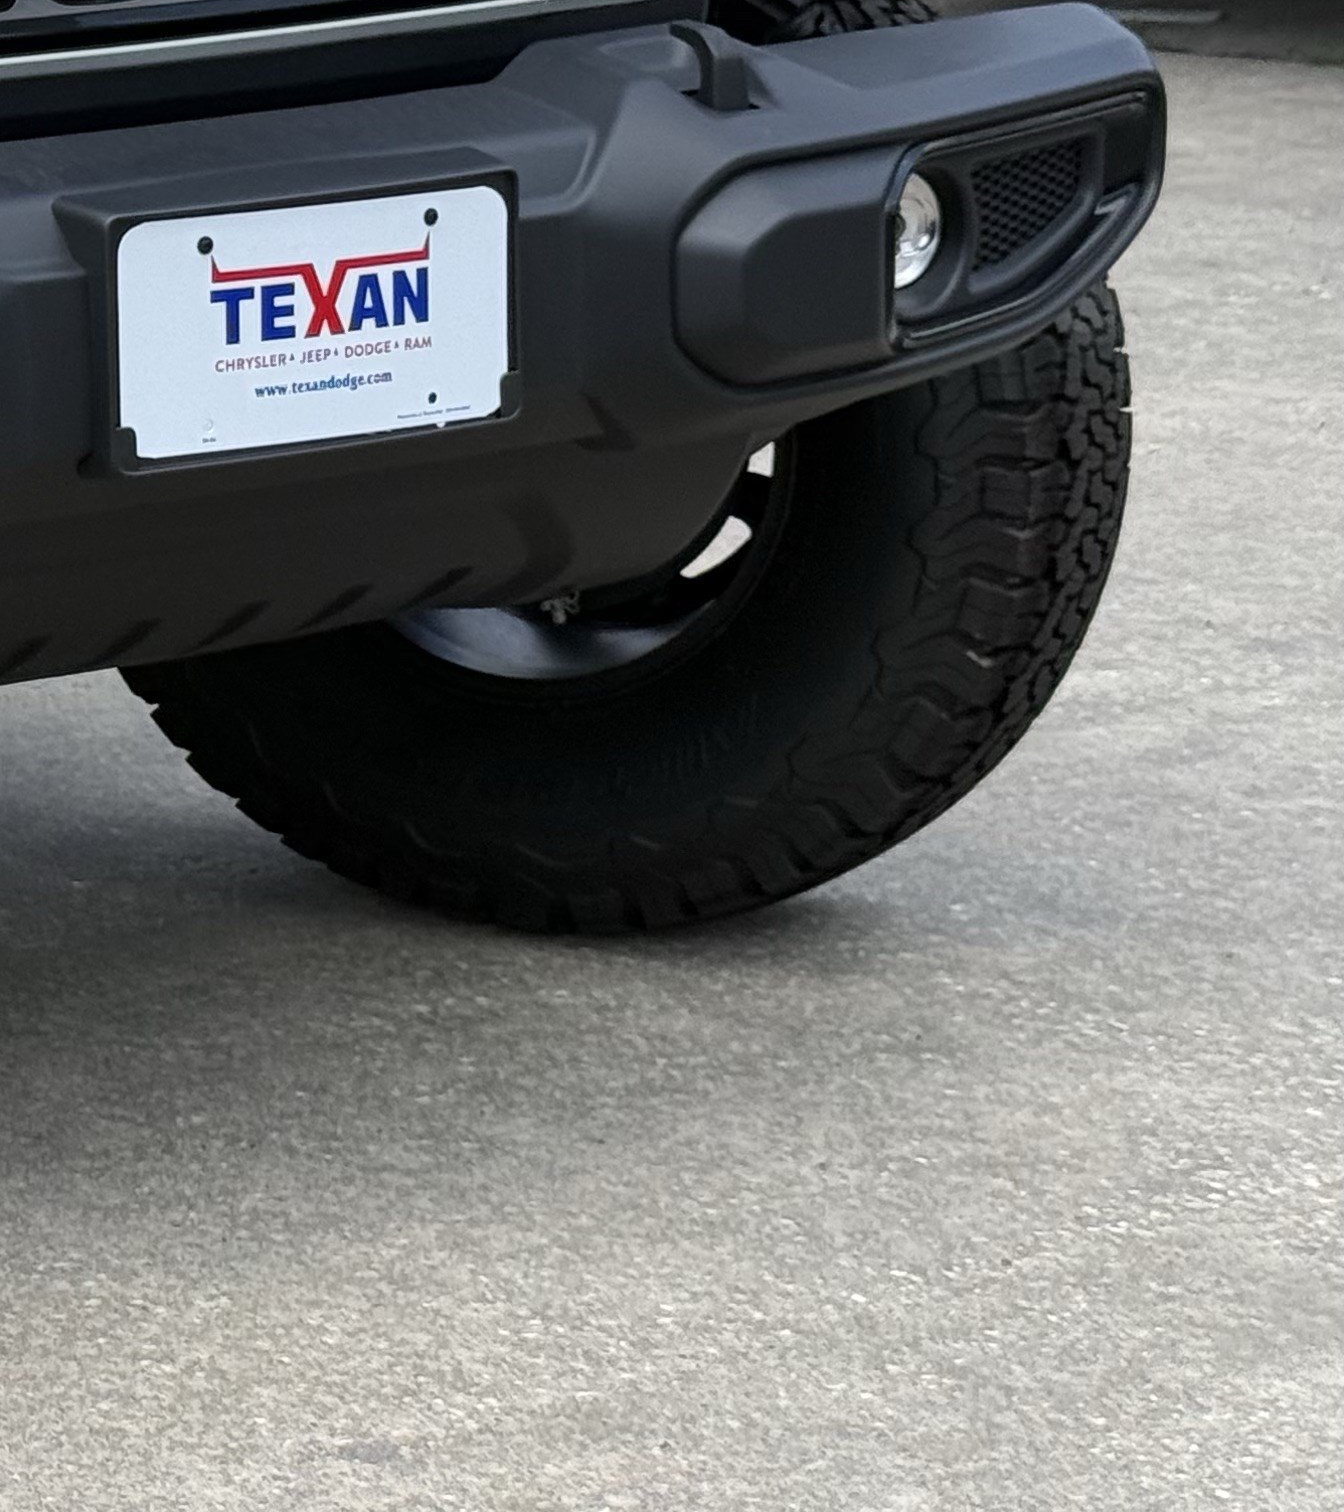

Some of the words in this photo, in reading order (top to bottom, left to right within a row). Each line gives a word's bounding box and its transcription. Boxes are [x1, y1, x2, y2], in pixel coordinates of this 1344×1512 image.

[209, 240, 430, 345] TEXAN
[215, 352, 287, 373] CHRYSLER
[300, 348, 331, 365] JEEP
[344, 340, 392, 359] DODGE
[404, 336, 433, 351] RAM
[254, 370, 393, 398] www.texandodge.com
